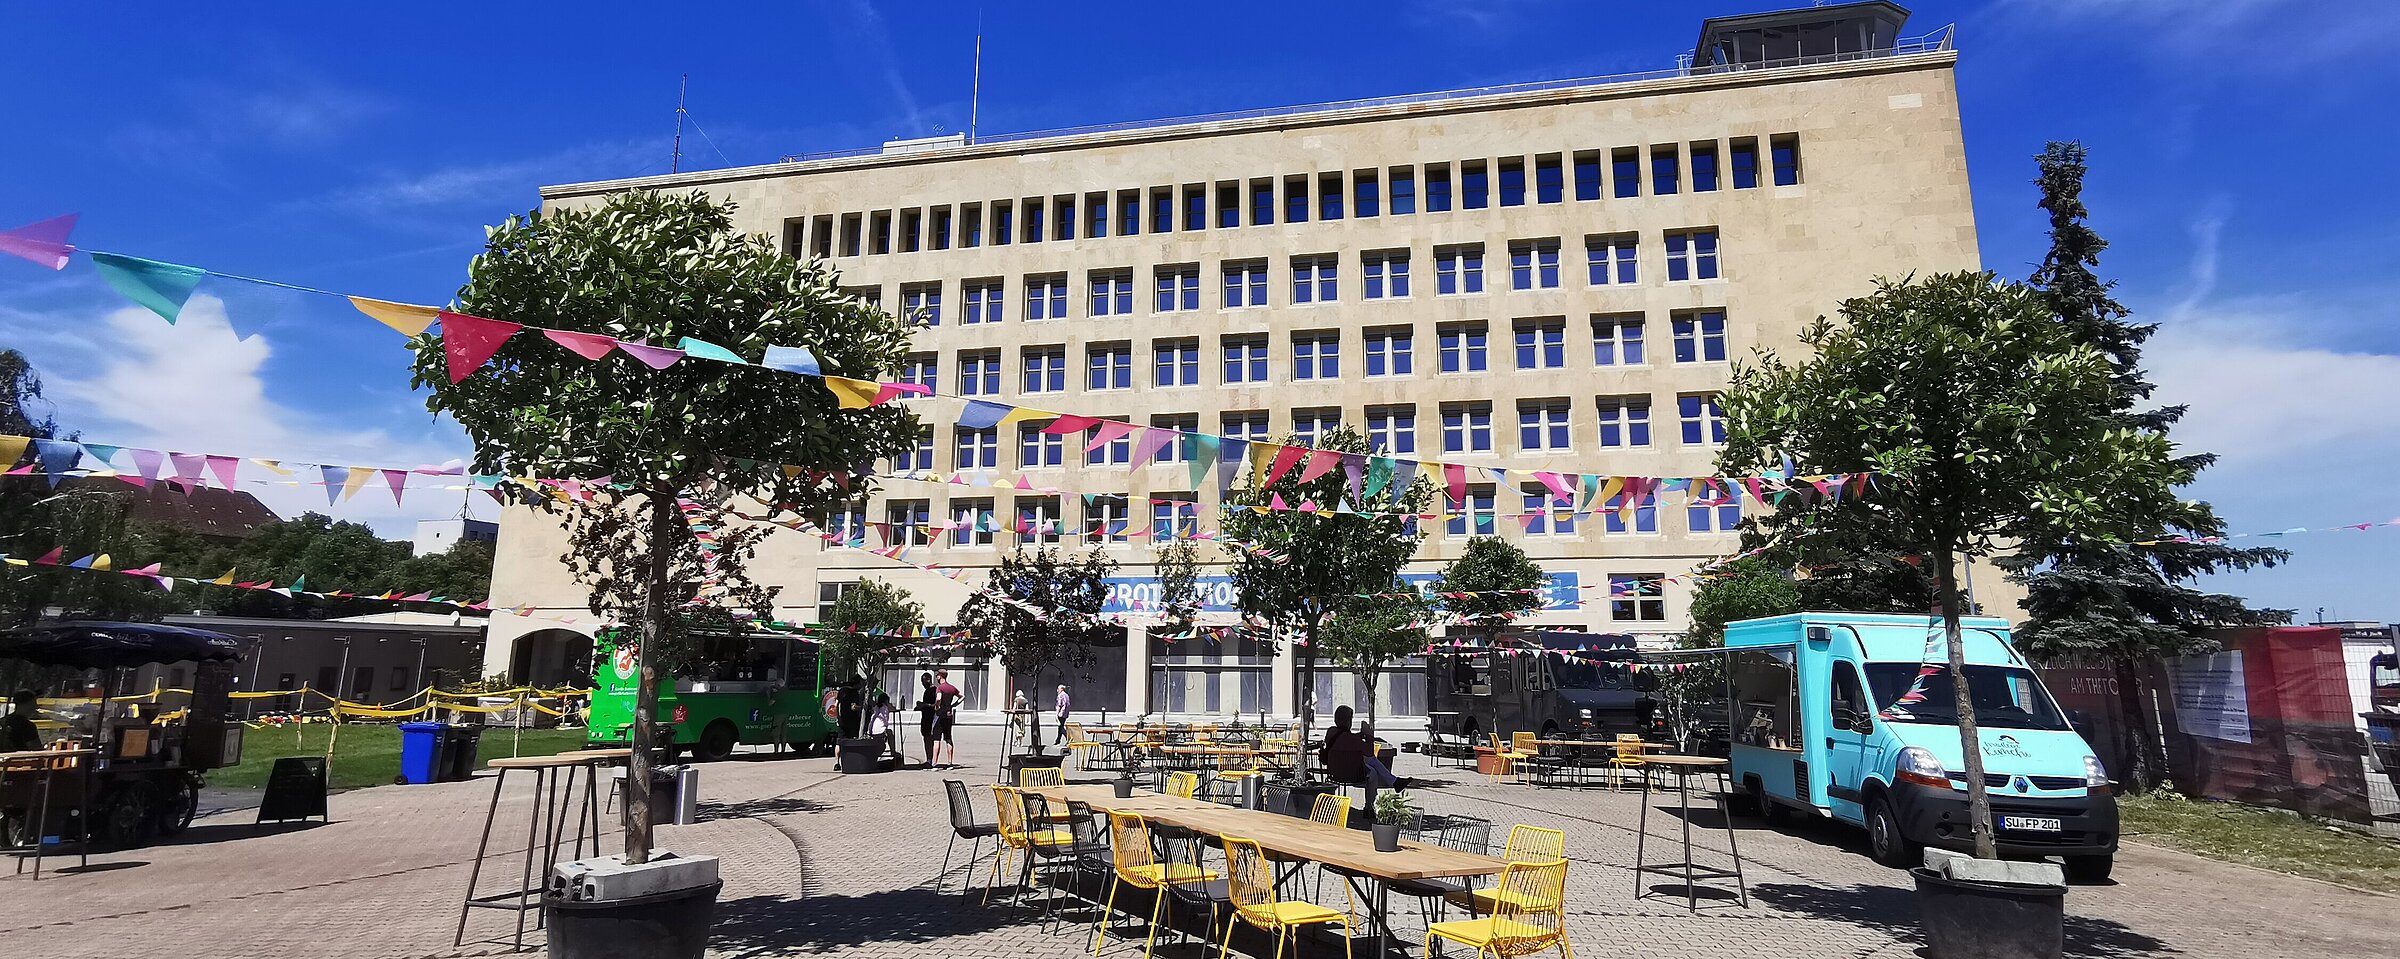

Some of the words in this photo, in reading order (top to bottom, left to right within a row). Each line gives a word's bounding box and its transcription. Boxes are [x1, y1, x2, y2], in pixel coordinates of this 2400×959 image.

[1102, 582, 1241, 606] PROTTIO
[2070, 677, 2085, 695] AM
[2005, 817, 2019, 828] SU
[2025, 818, 2040, 829] FP
[2041, 819, 2060, 830] 201
